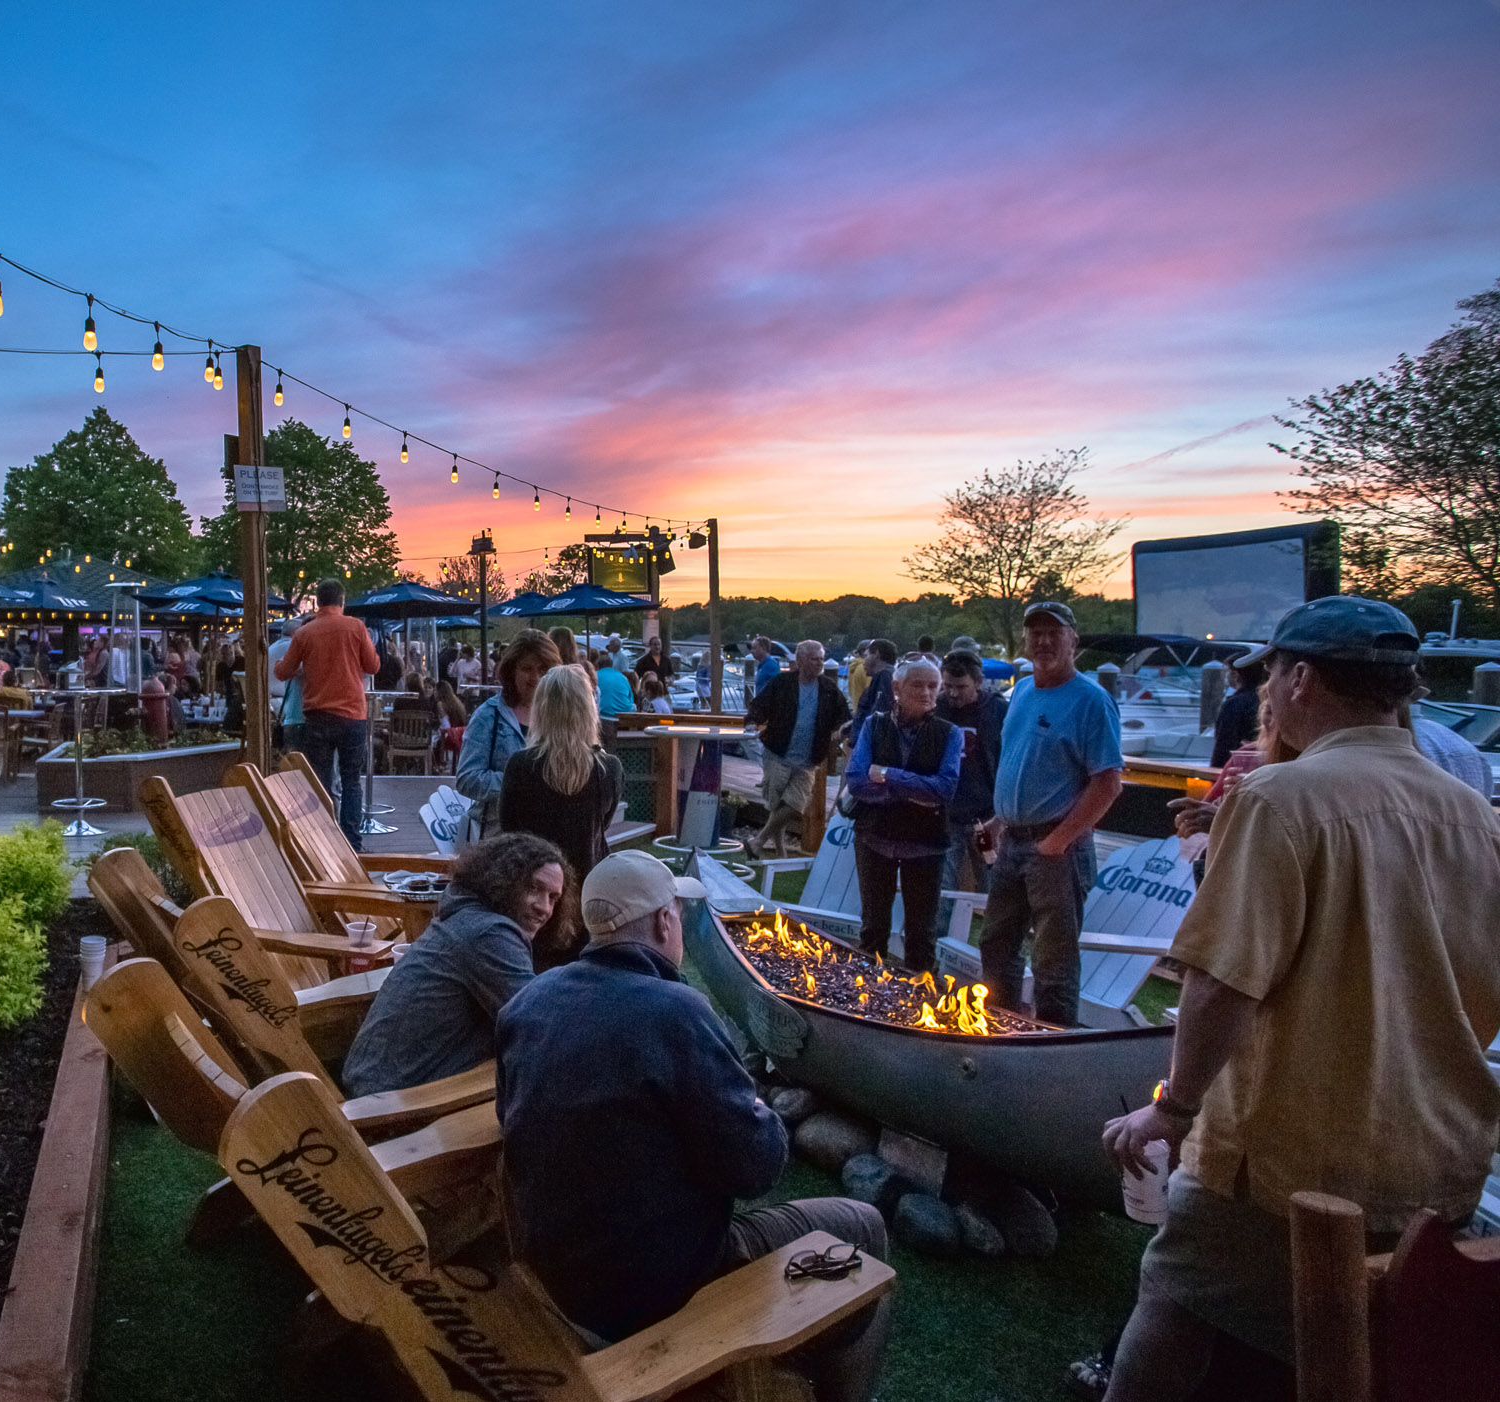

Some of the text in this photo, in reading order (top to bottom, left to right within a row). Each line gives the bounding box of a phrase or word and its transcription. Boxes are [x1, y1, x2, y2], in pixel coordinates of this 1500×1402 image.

[240, 470, 279, 480] PLEASE
[1098, 864, 1192, 908] Corona
[822, 920, 858, 936] beach.
[182, 927, 298, 1029] Leinenkugel's
[236, 1128, 429, 1285] Leinenkugel's
